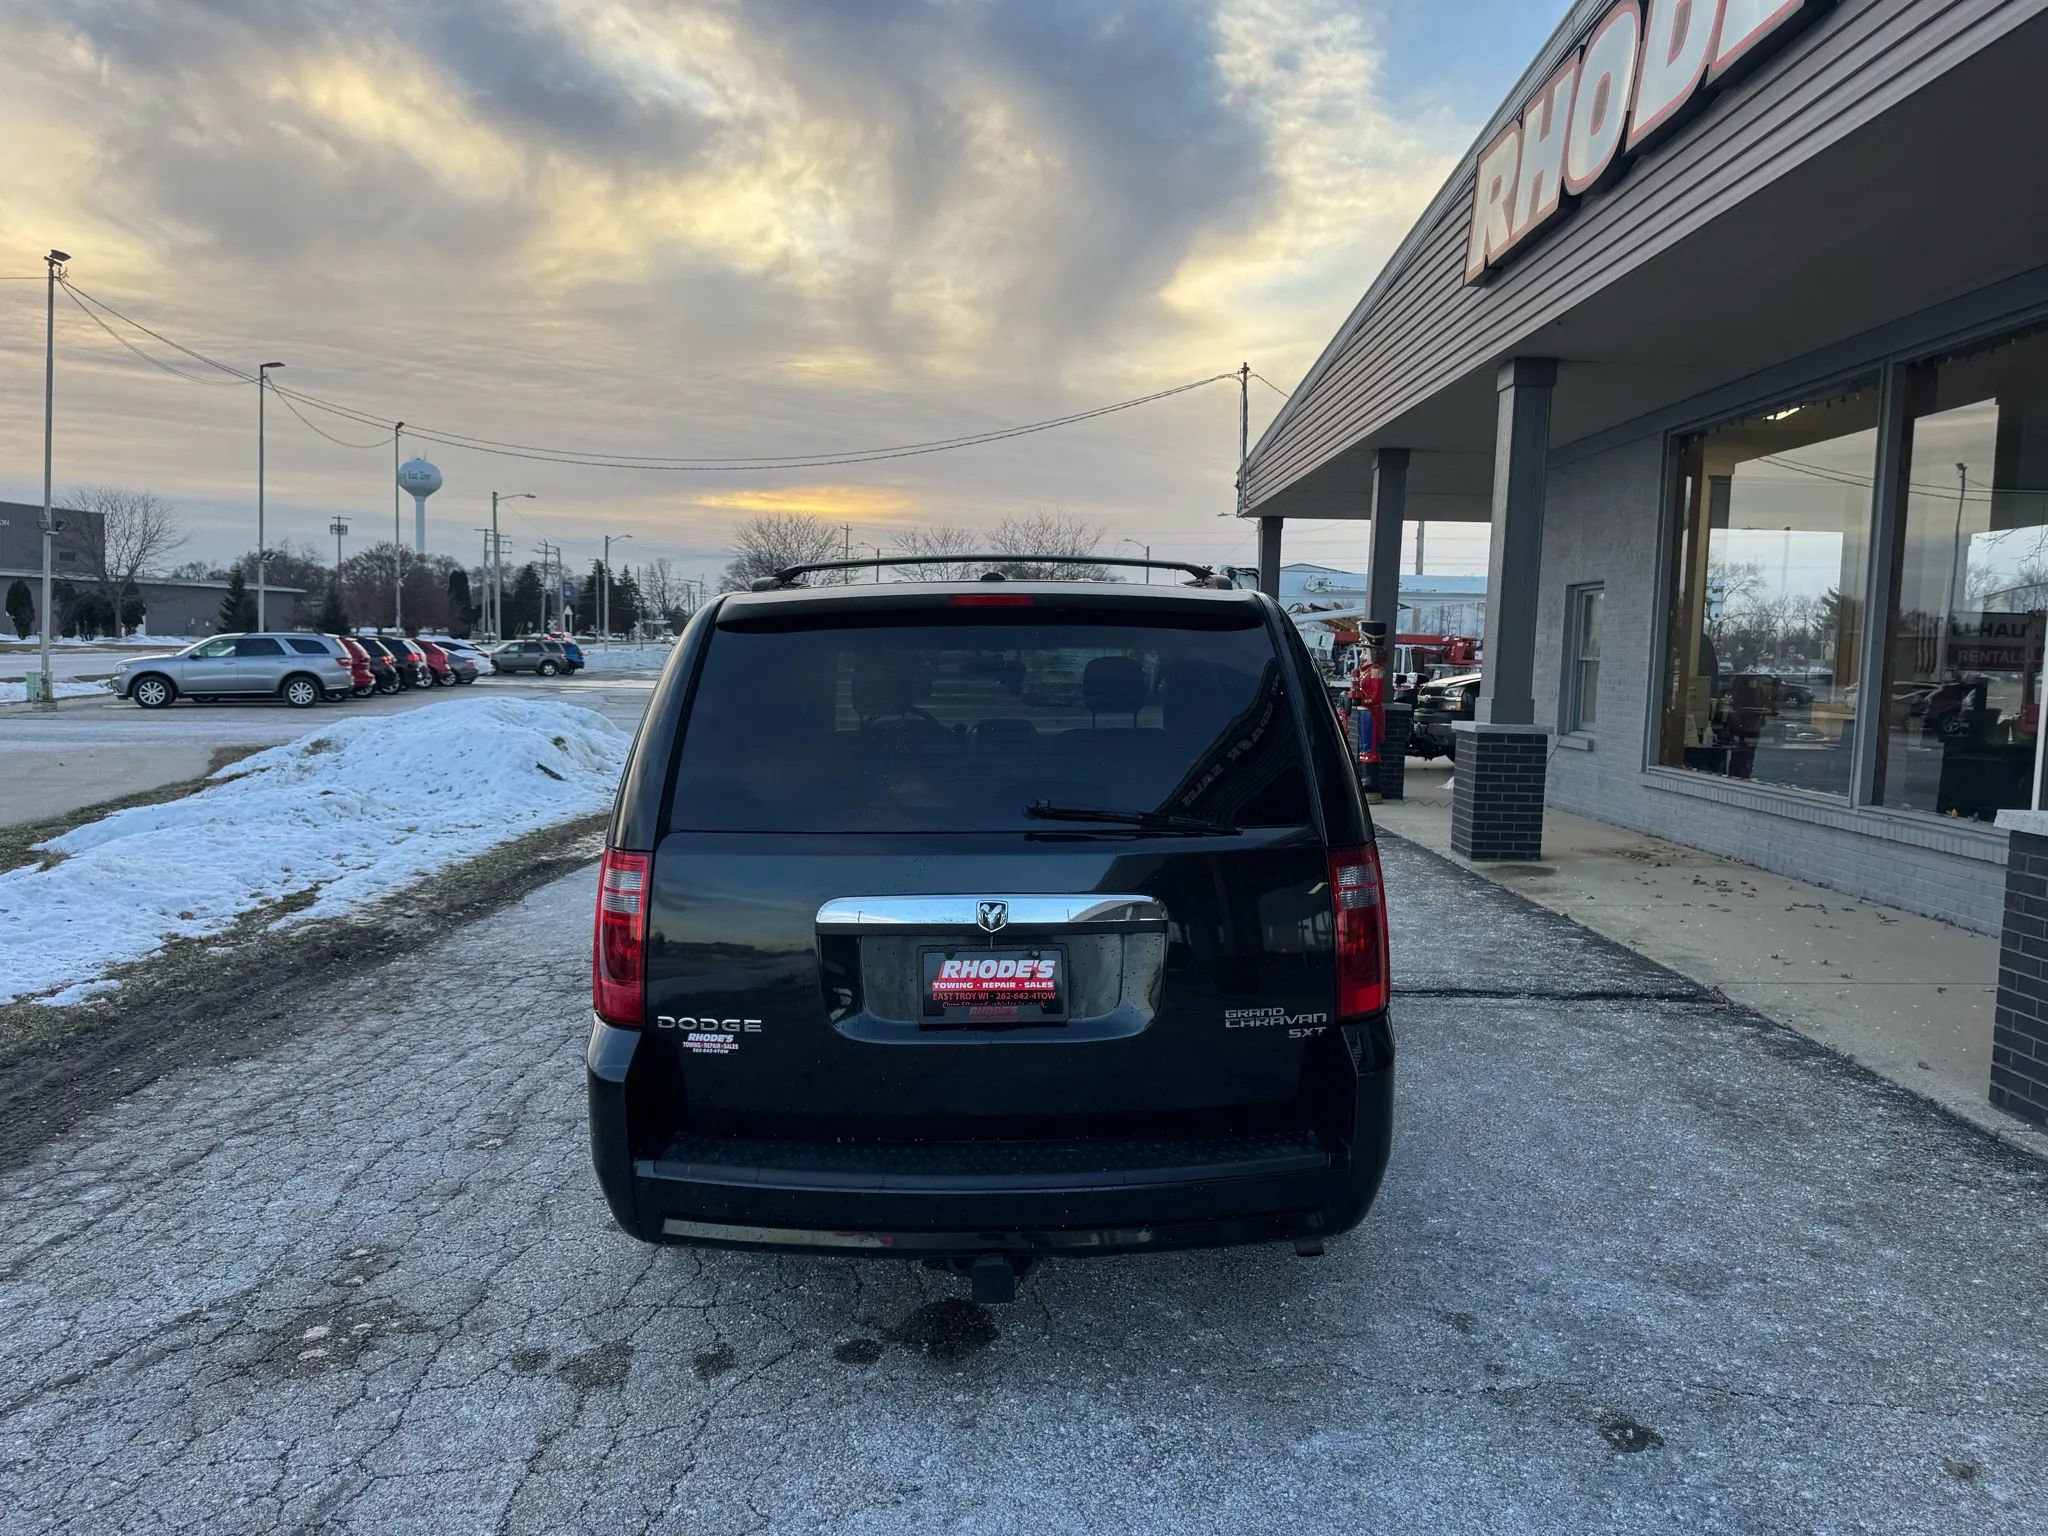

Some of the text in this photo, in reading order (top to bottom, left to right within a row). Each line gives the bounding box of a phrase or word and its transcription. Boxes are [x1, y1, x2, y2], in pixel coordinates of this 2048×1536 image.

[1952, 622, 2033, 638] U-HAU
[941, 959, 1056, 979] RHODE'S
[933, 992, 1056, 1000] EAST TROY WI 262-642-4TOW
[1225, 1007, 1284, 1018] GRAND
[657, 1015, 762, 1032] DODGE
[1225, 1013, 1327, 1028] CARAVAN
[687, 1033, 734, 1043] RHODE'S
[1288, 1026, 1327, 1038] SXT
